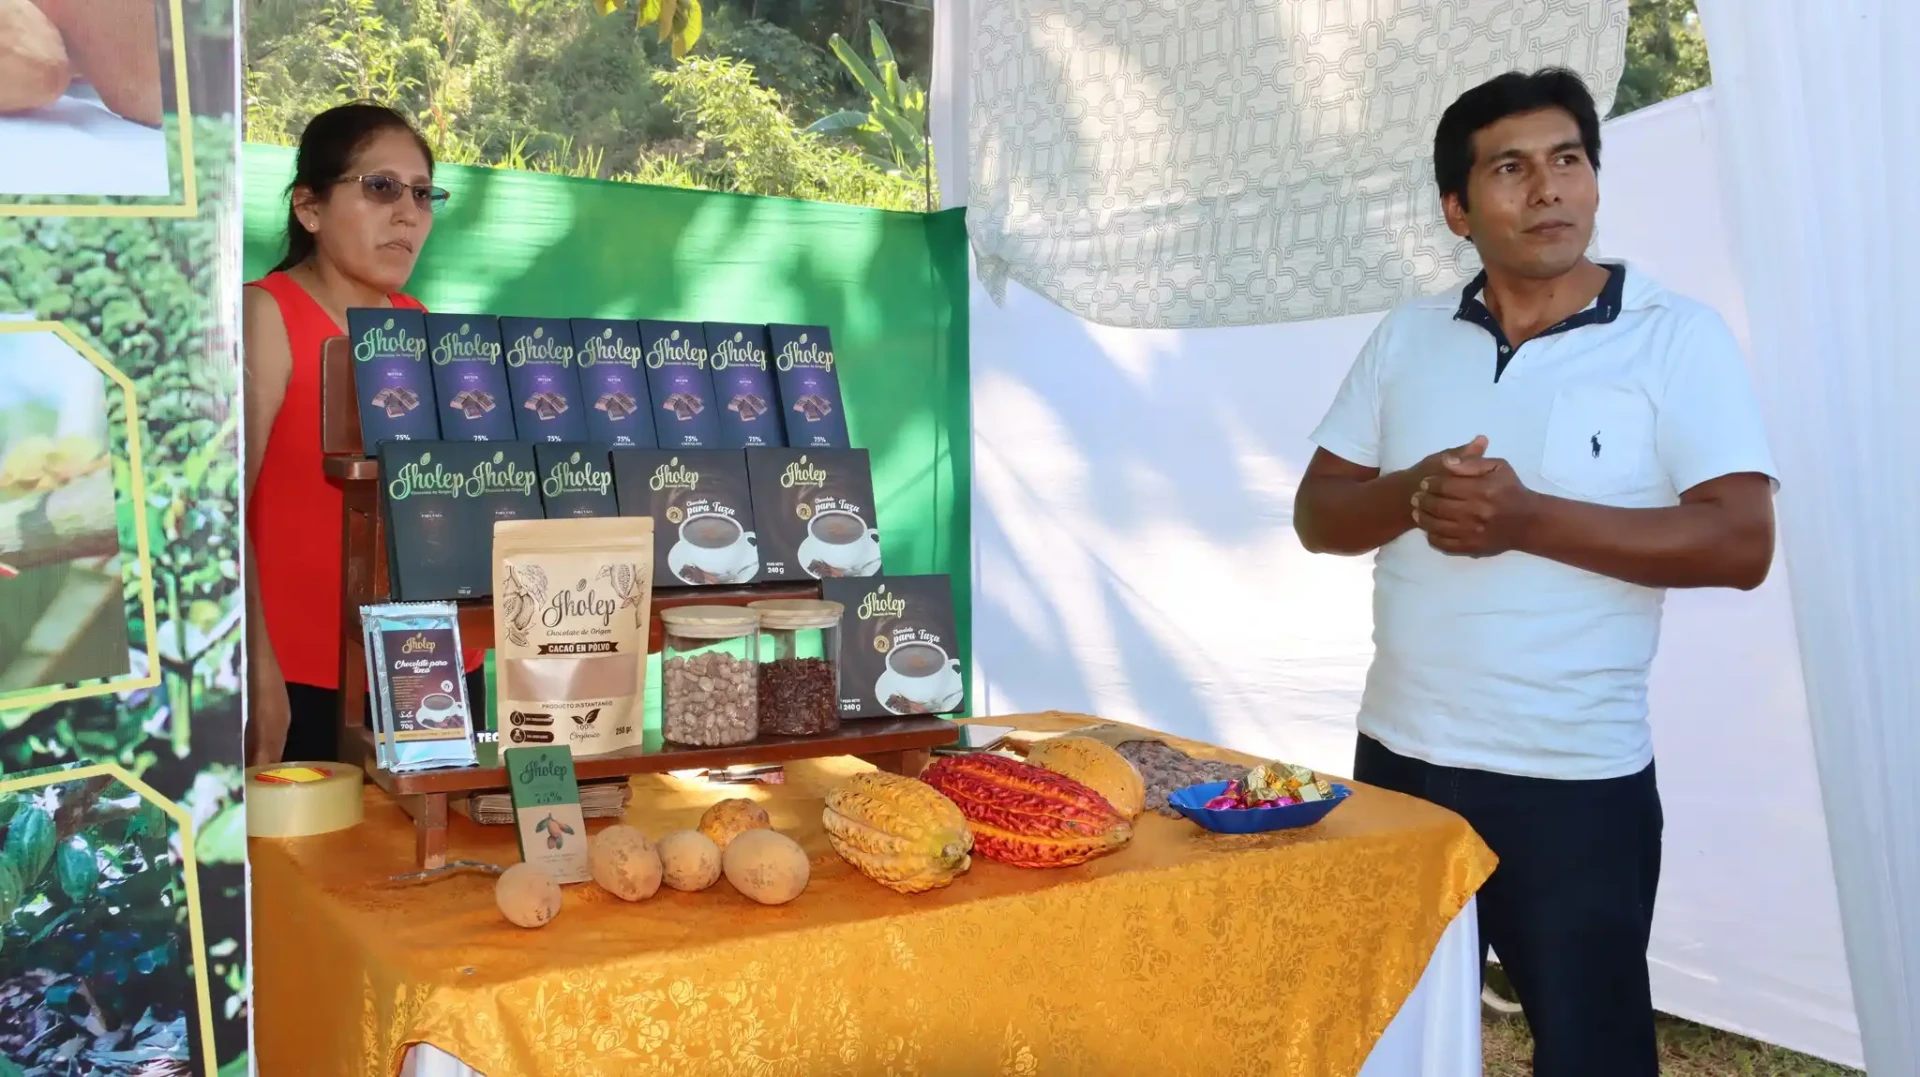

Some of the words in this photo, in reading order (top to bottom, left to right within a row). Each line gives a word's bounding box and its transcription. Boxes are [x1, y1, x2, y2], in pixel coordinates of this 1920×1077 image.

[354, 327, 427, 362] Jholep
[432, 332, 501, 365] Jholep
[507, 335, 574, 369] Jholep
[577, 336, 642, 369] Jholep
[646, 338, 708, 371] Jholep
[776, 341, 834, 373] Jholep
[389, 462, 464, 500] Jholep
[465, 461, 536, 498] Jholep
[543, 461, 611, 498] Jholep
[649, 464, 699, 491] Jholep
[780, 462, 826, 488] Jholep
[686, 504, 710, 517] para
[712, 501, 735, 516] Taza
[815, 501, 836, 514] para
[838, 499, 860, 514] Taza
[541, 590, 616, 628] Jholep
[857, 591, 906, 620] Jholep
[402, 637, 436, 654] Jholep
[590, 628, 612, 636] Origen
[893, 632, 916, 647] para
[917, 629, 940, 645] Taza
[548, 644, 574, 653] CACAO
[575, 643, 587, 652] EN
[394, 659, 429, 670] Chocolate
[428, 660, 448, 668] para
[520, 760, 568, 785] Jholep
